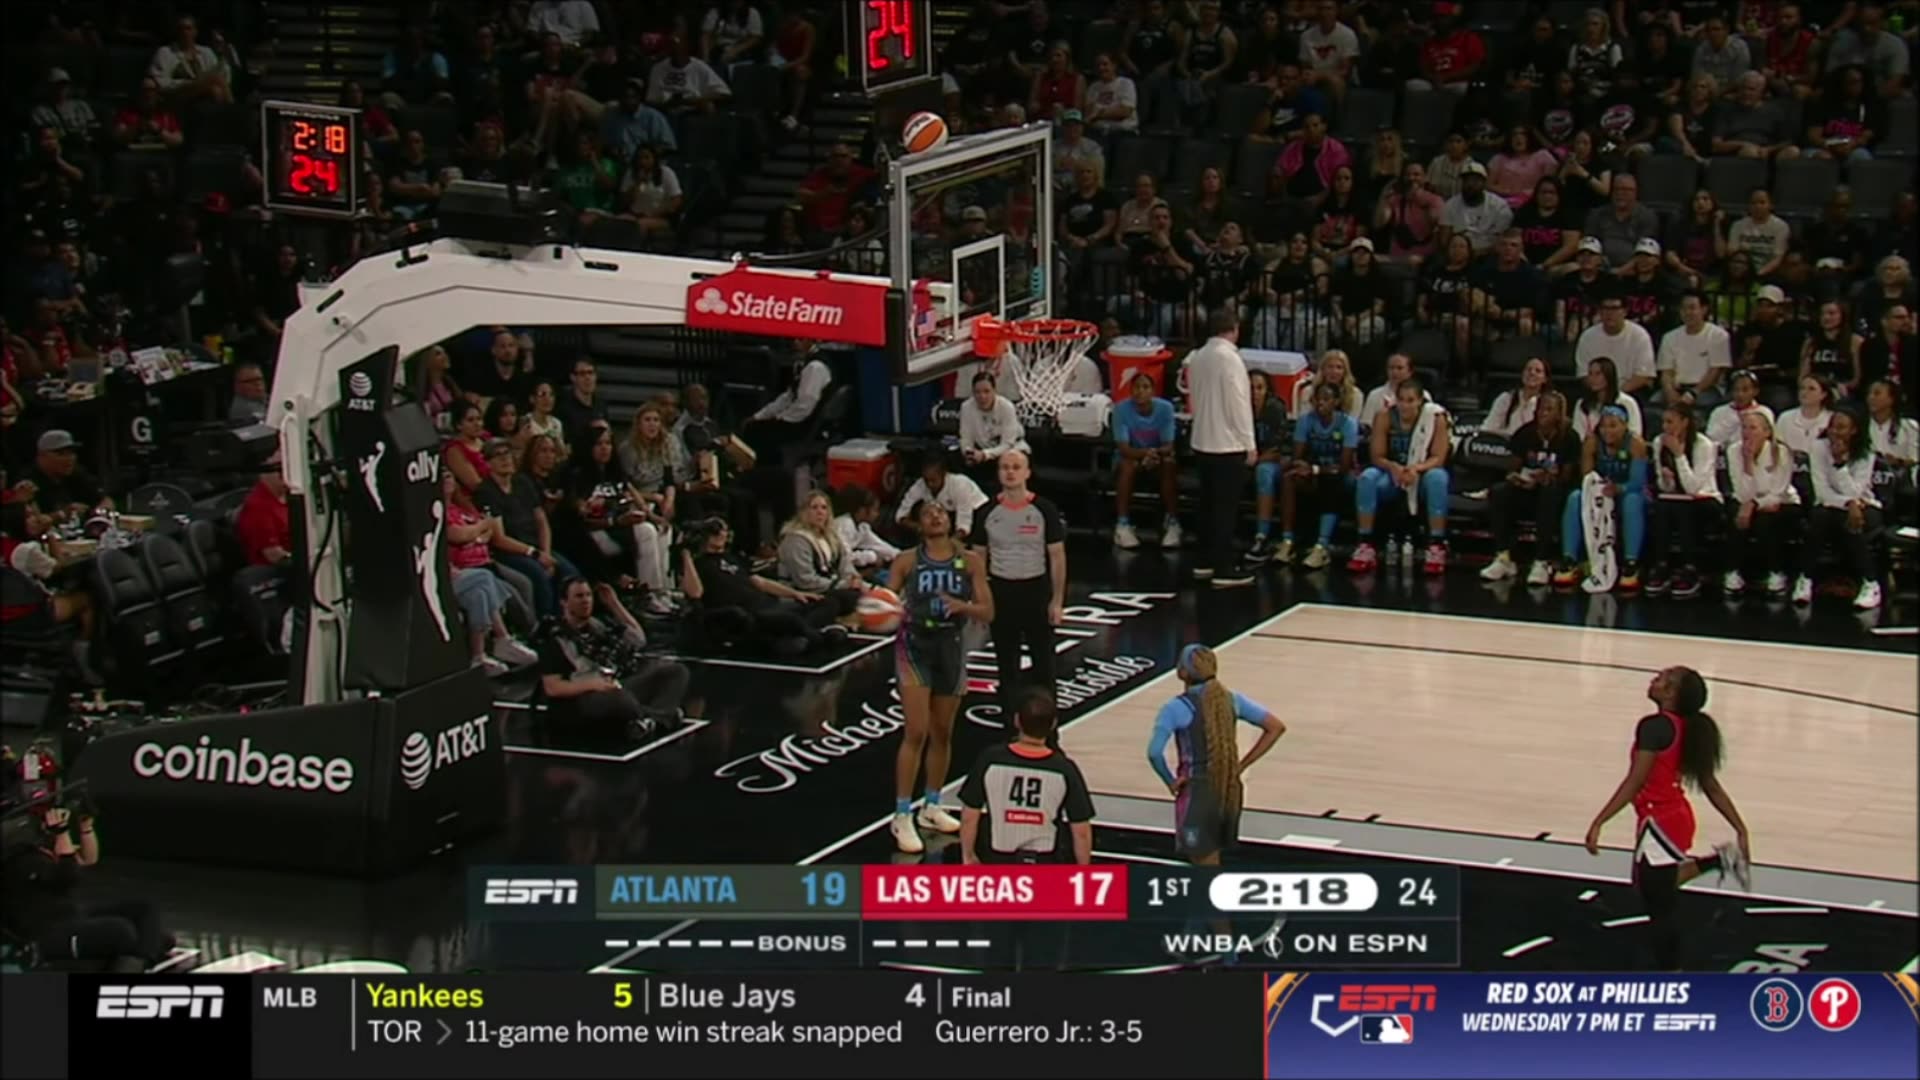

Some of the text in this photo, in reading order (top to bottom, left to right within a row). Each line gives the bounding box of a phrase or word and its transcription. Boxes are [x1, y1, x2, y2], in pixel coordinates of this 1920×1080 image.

[867, 0, 914, 69] 24
[294, 121, 345, 153] 2:18
[291, 155, 337, 192] 24
[347, 398, 376, 411] AT&T
[131, 416, 152, 443] G
[407, 450, 440, 483] ally
[434, 714, 490, 770] AT&T
[714, 678, 905, 793] Michelo
[134, 735, 353, 792] coinbase
[1009, 775, 1043, 808] 42
